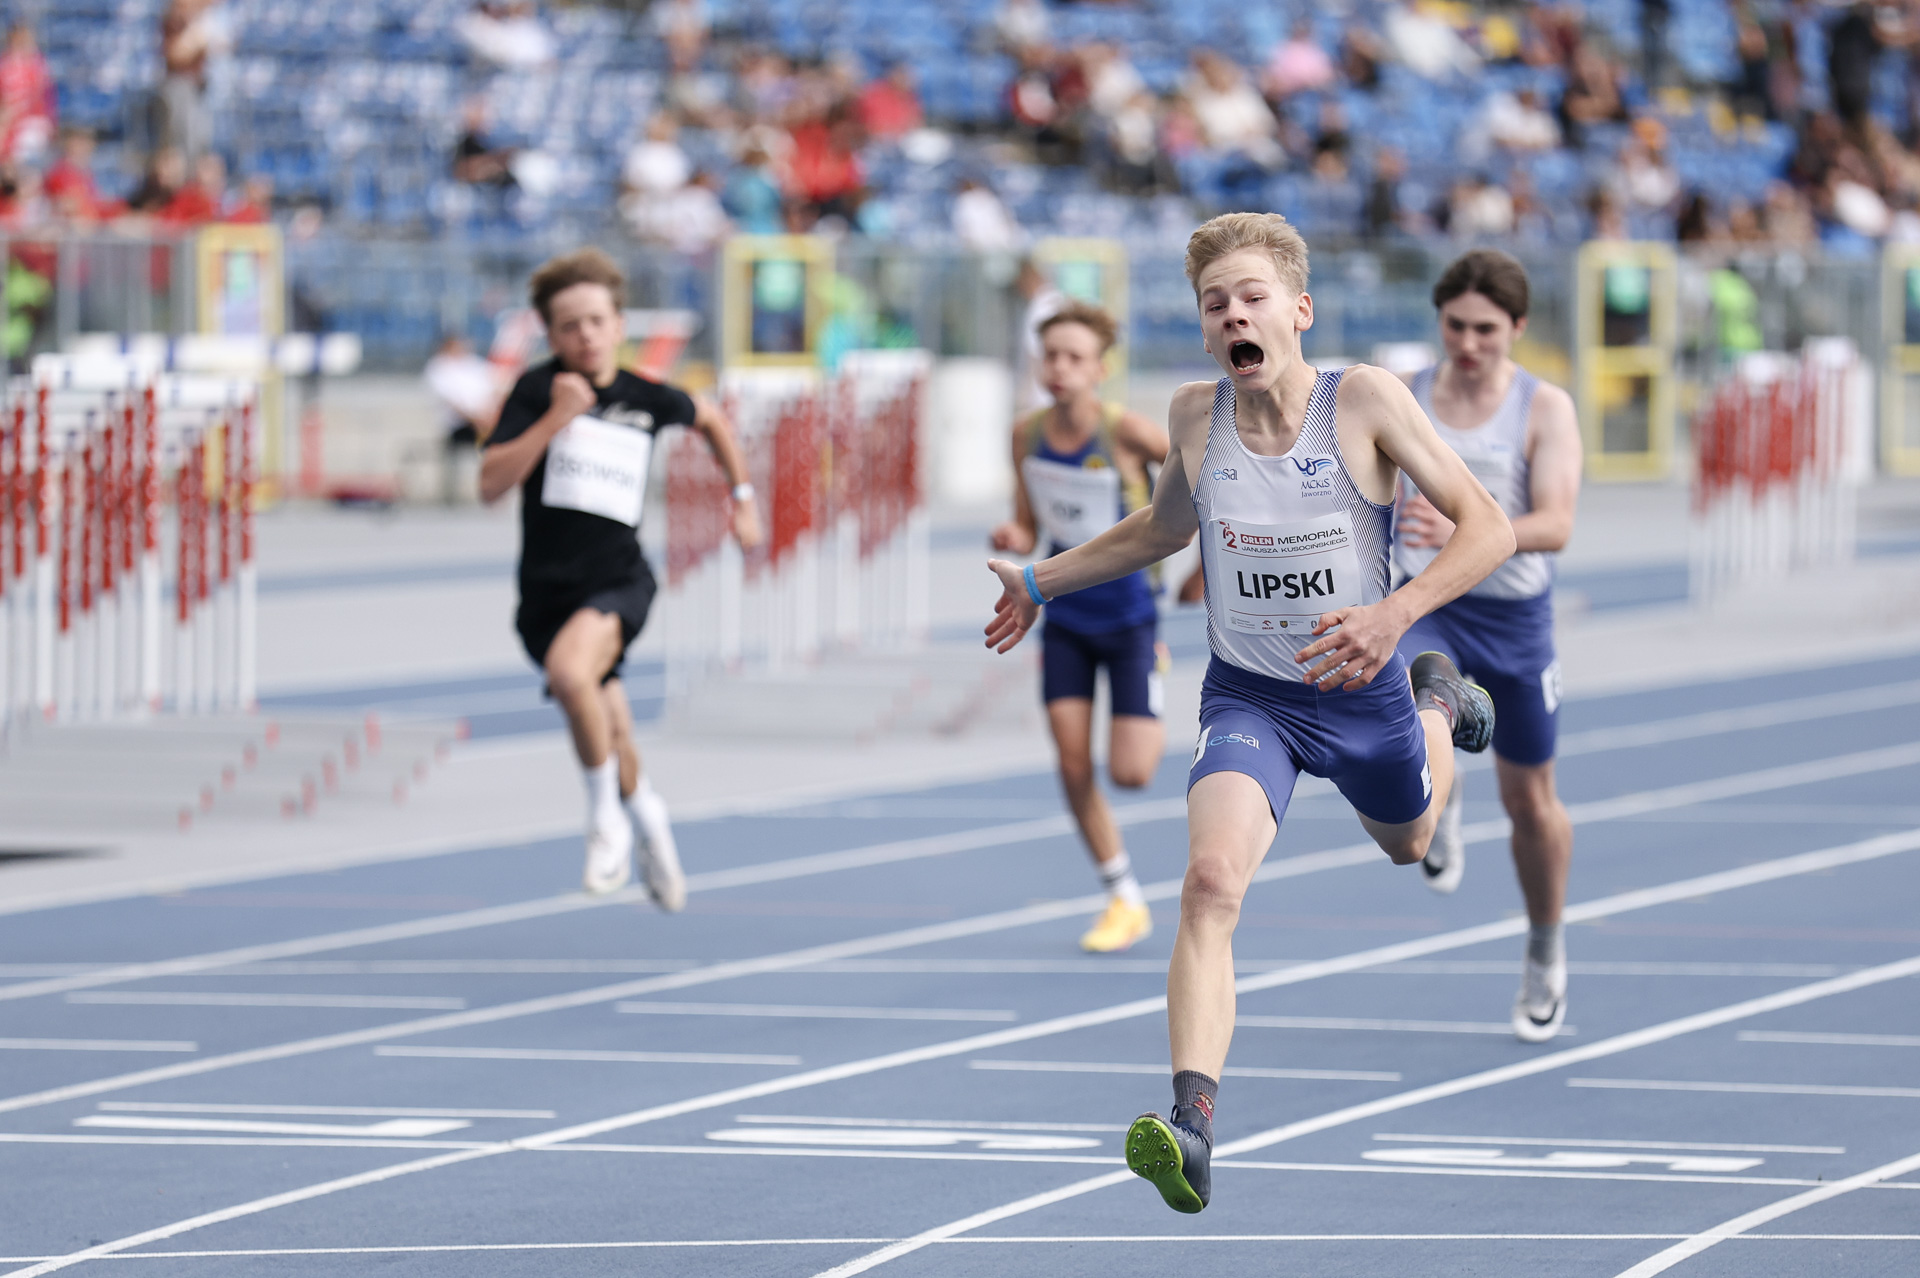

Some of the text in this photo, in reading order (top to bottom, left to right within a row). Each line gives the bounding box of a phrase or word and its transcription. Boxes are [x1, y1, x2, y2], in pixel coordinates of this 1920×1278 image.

[1213, 468, 1239, 481] esa
[1301, 489, 1333, 499] Jaworzno
[1241, 534, 1273, 545] ORLEN
[1277, 527, 1346, 545] MEMORIAŁ
[1241, 536, 1348, 554] JANUSZA KUSOCIŃSKIEGO
[1236, 568, 1336, 600] LIPSKI
